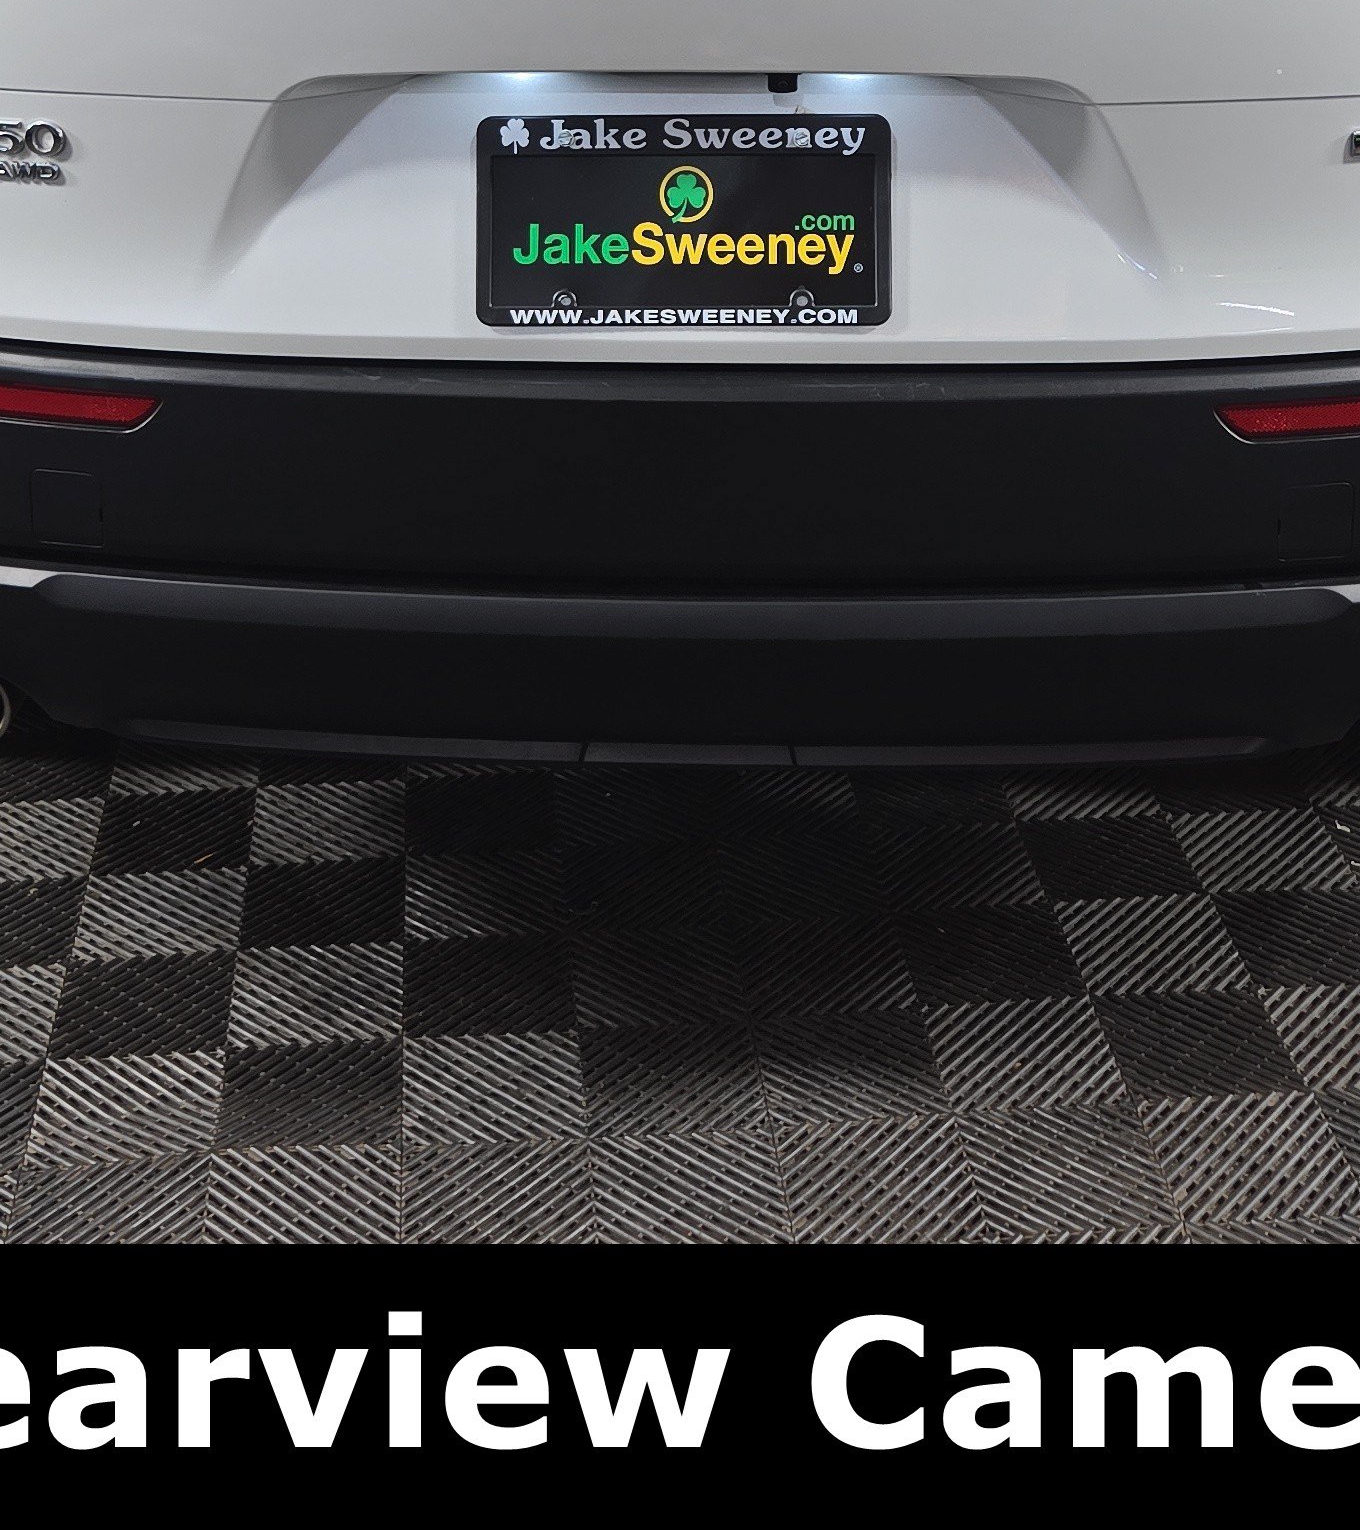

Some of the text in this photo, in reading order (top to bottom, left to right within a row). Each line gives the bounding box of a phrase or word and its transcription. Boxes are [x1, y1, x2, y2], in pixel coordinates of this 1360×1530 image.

[540, 118, 866, 156] Jake Sweeney
[509, 308, 859, 325] WWW.JAKESWEENEY.COM
